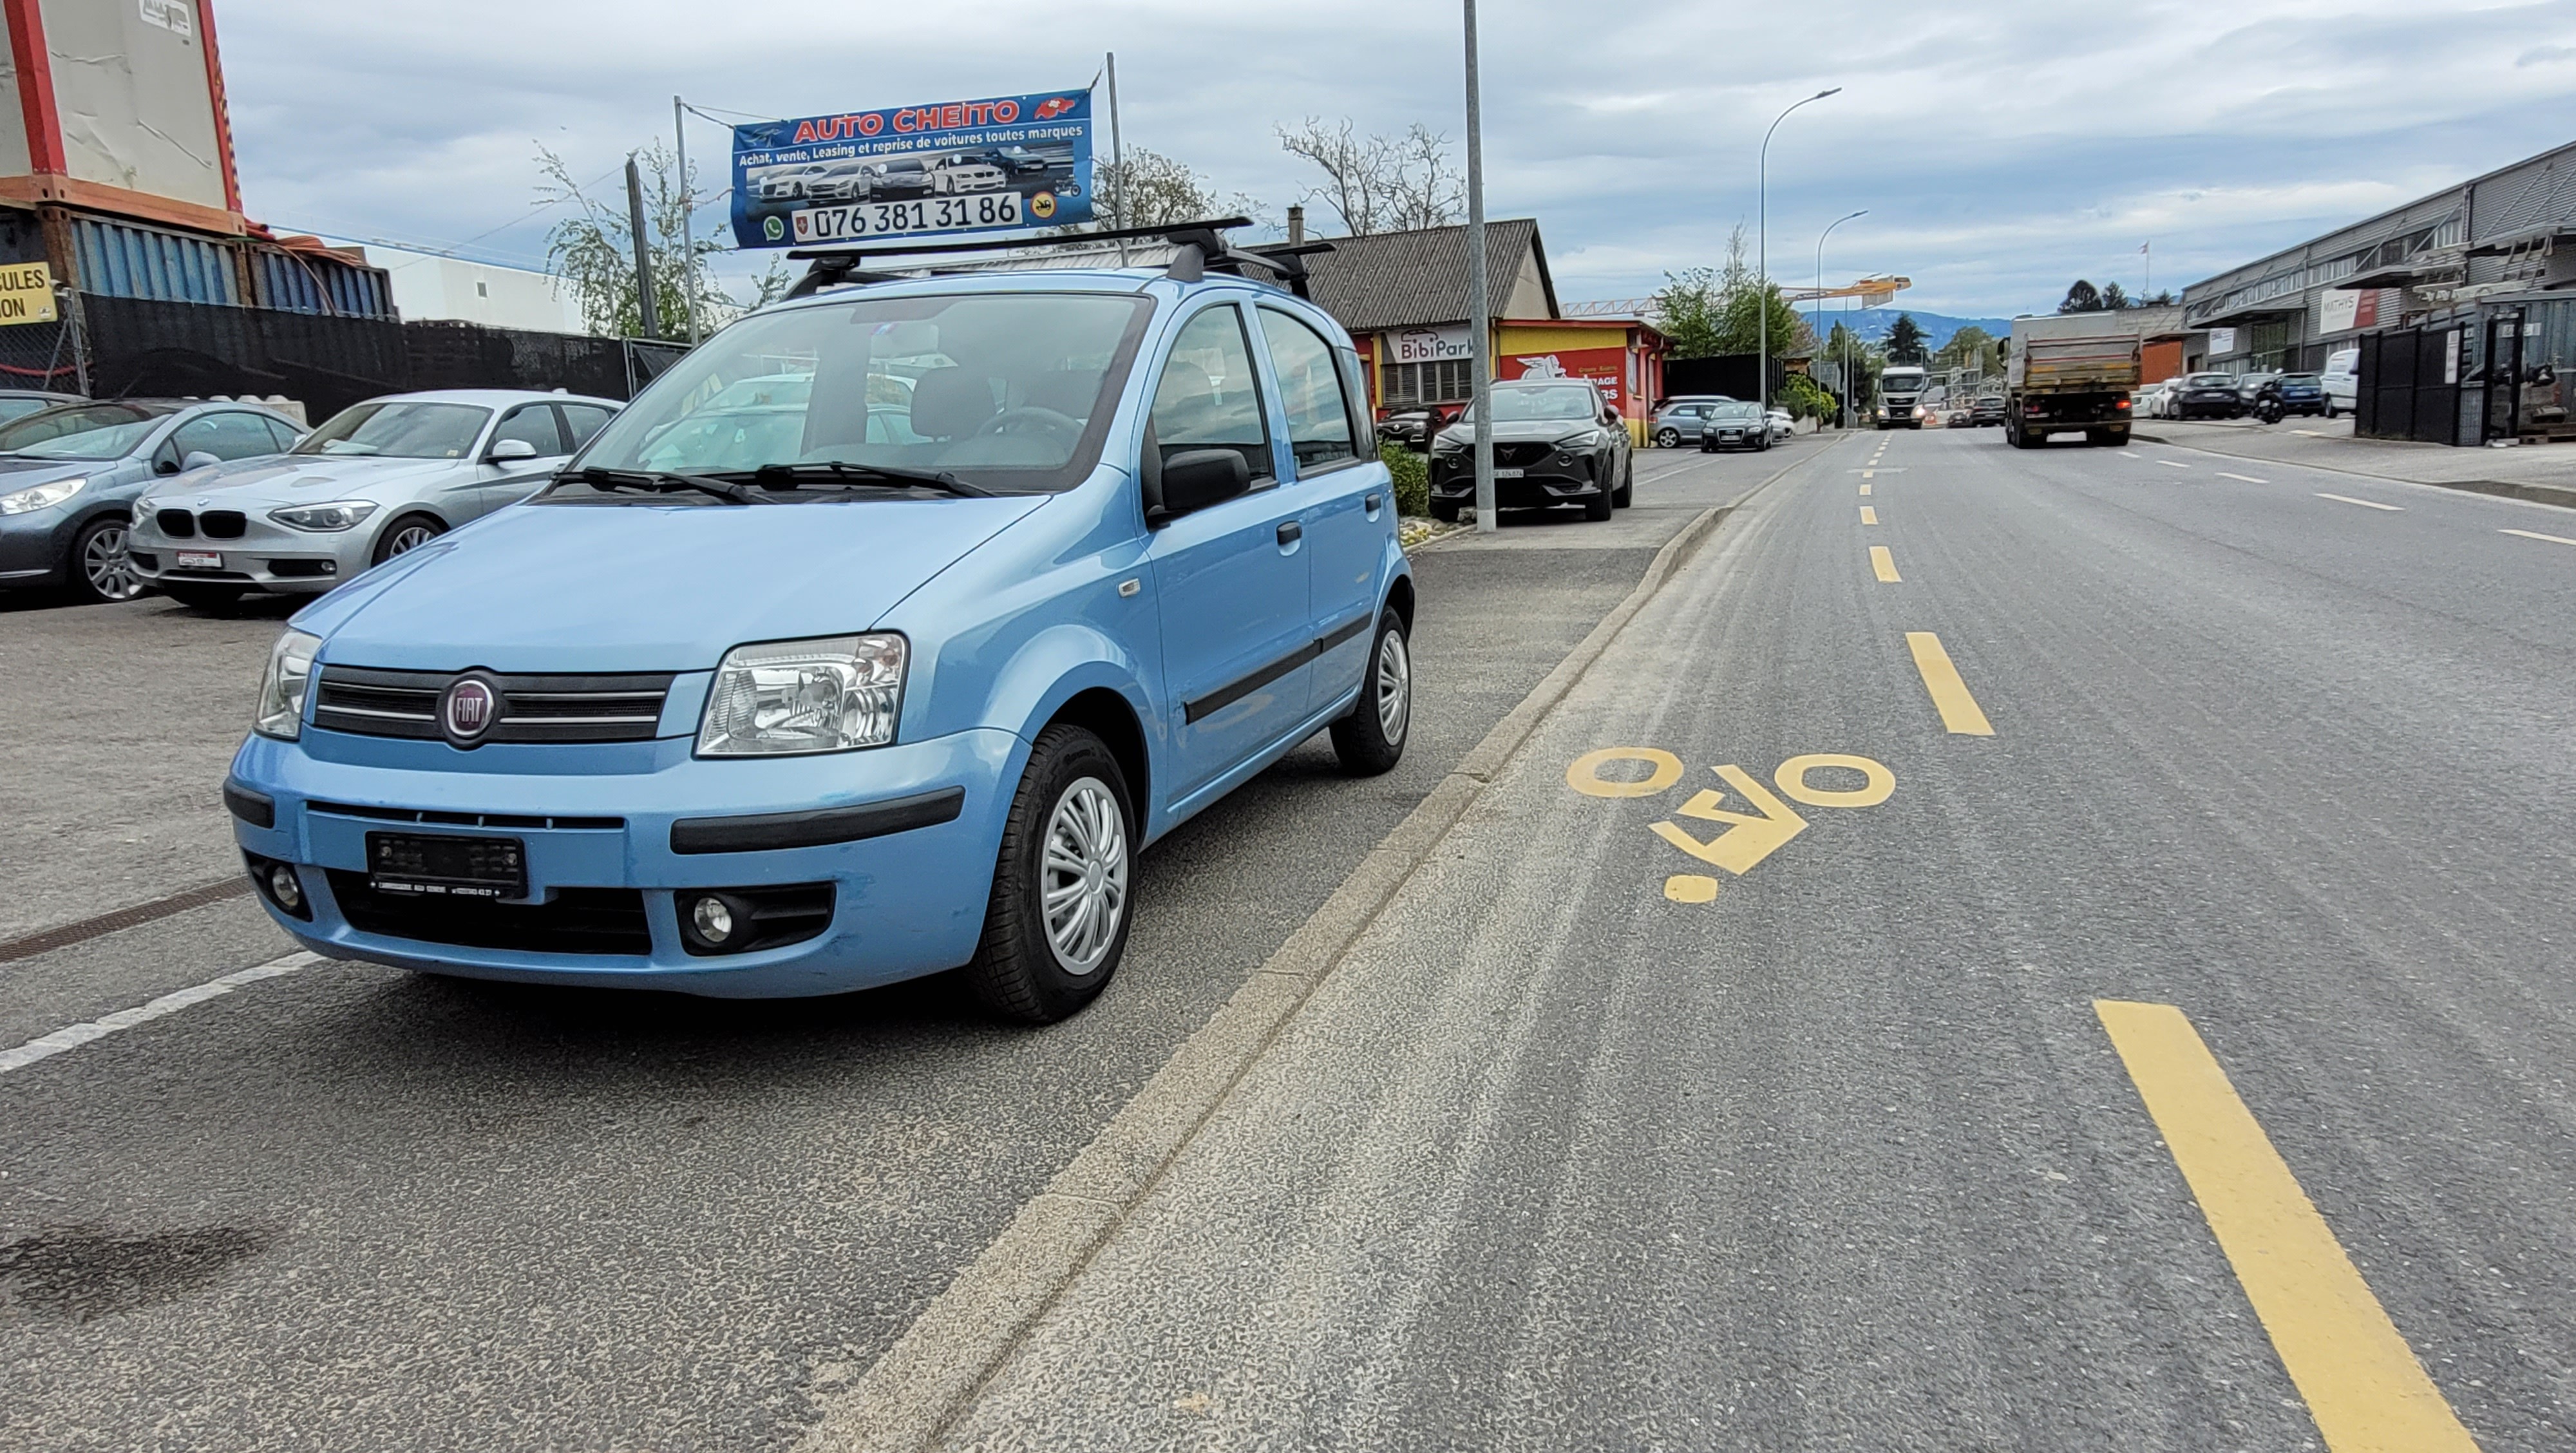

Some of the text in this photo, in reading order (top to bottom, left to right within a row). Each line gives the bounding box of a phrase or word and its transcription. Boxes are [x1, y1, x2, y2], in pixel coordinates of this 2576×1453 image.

[793, 100, 1019, 143] AUTO CHEITO
[739, 125, 1083, 167] Achat, vente, Leasing et reprise de voitures toutes marques
[814, 195, 1016, 237] 076 381 31 86
[0, 269, 45, 292] ULES
[1401, 337, 1473, 359] BibiPark
[456, 698, 484, 722] FIAT
